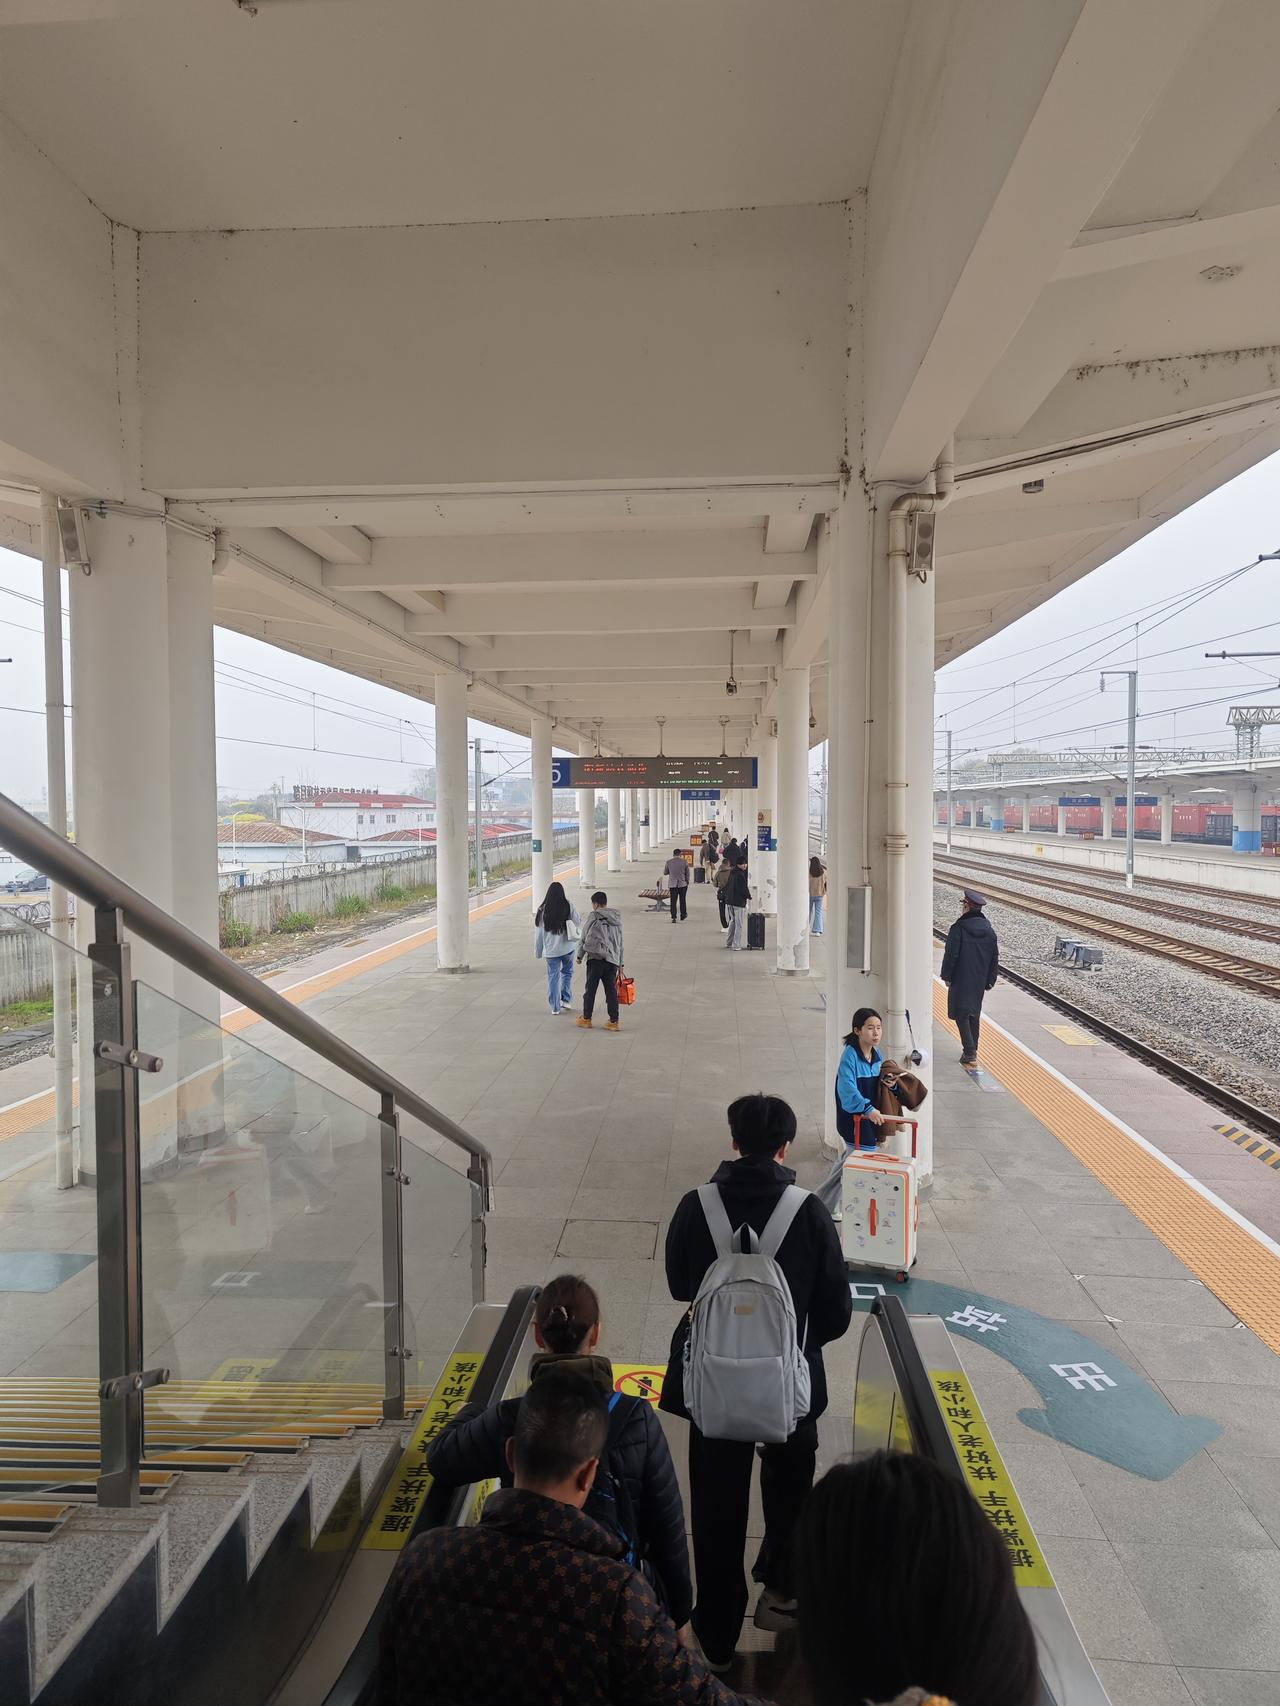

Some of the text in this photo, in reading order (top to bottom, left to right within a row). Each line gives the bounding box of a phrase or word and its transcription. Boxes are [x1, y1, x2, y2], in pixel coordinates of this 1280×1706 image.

[552, 763, 562, 784] 5
[936, 1380, 998, 1481] 扶好老人和小孩
